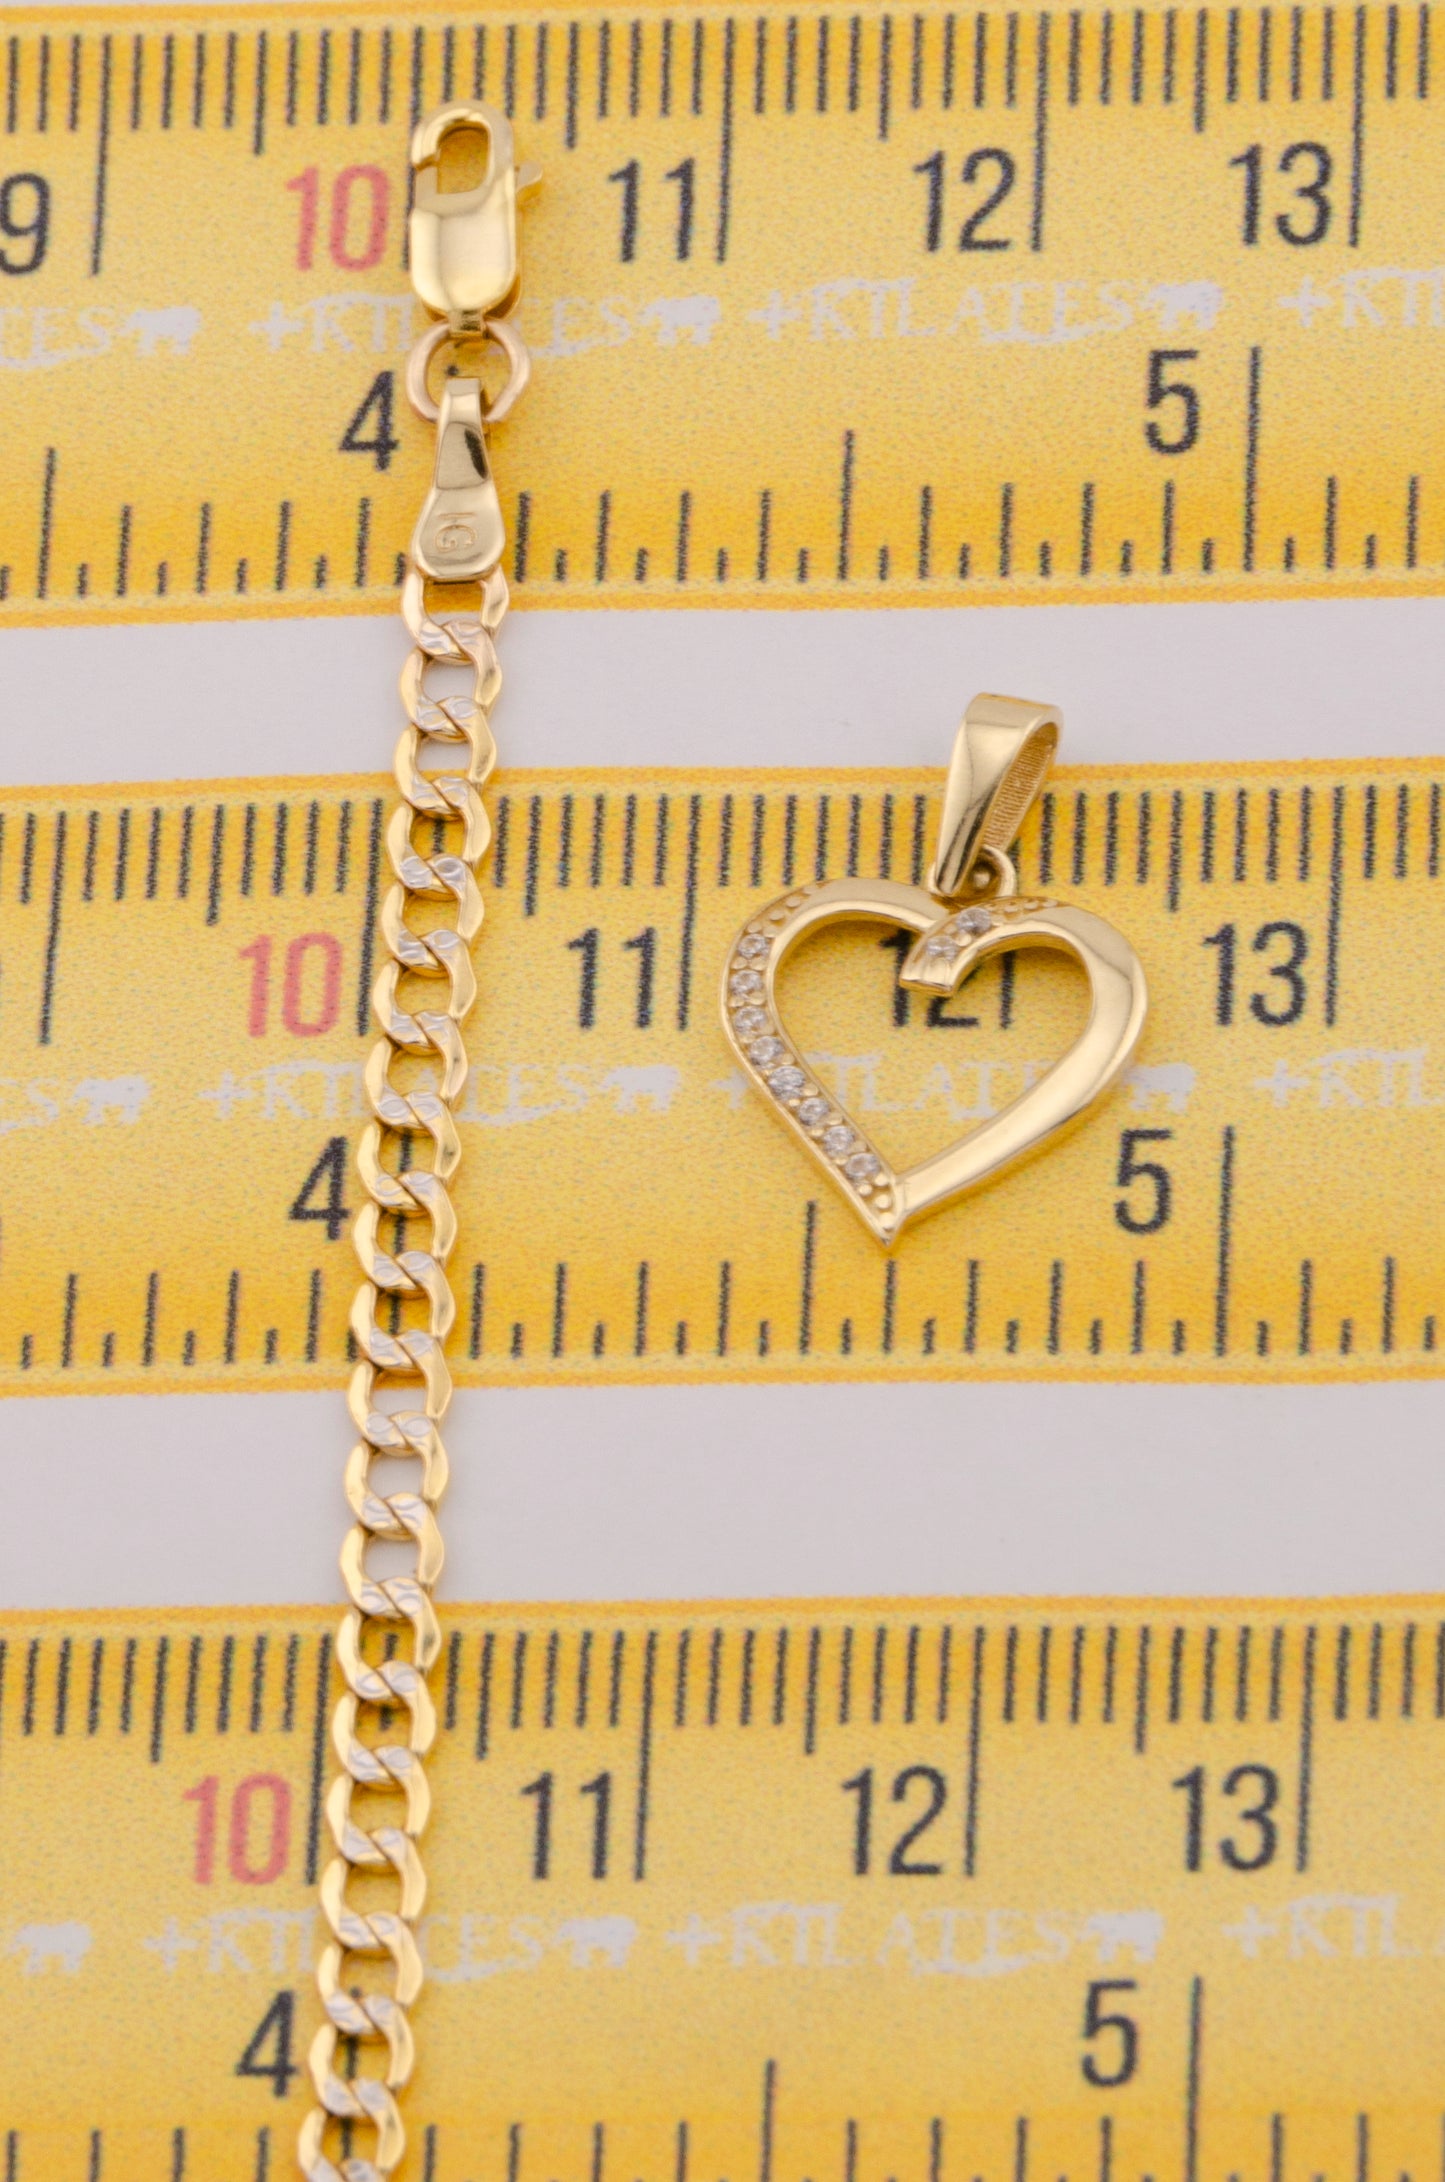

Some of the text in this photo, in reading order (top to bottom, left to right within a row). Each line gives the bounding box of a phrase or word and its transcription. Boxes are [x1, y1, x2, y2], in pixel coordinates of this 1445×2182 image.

[0, 142, 1333, 274] 9 10 11 12 13
[339, 350, 1200, 471] 4 5
[240, 932, 342, 1037] 10
[567, 927, 657, 1029] 11
[1203, 921, 1309, 1026] 13
[289, 1128, 1171, 1241] 4 5
[183, 1764, 1280, 1885] 10 11 12 13
[235, 1979, 1139, 2099] 4 5
